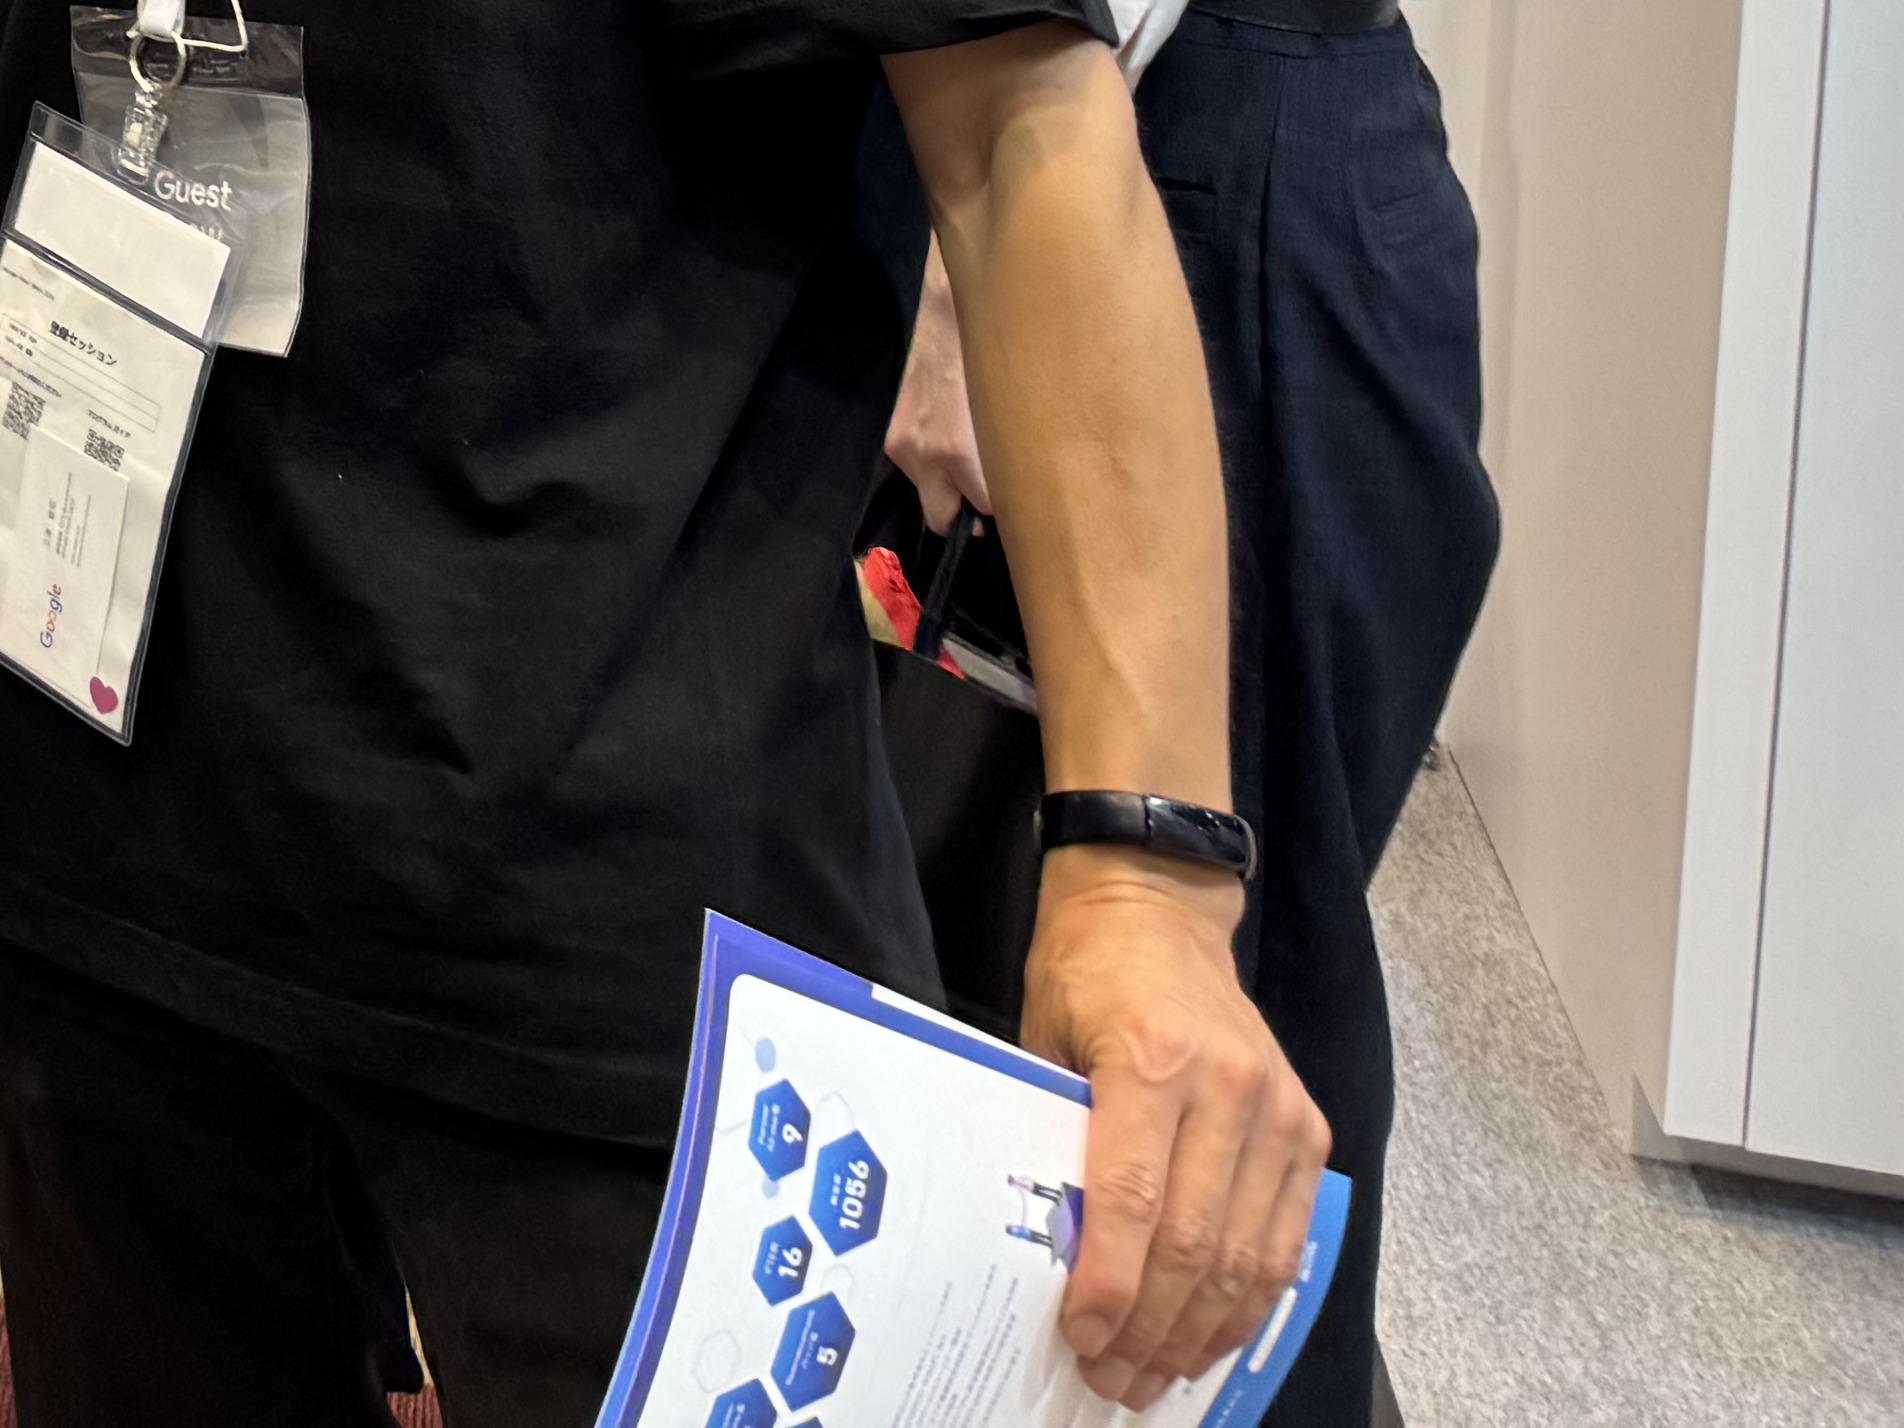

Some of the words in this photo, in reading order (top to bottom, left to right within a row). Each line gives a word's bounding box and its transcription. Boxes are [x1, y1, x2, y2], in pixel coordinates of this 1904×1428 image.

[154, 169, 233, 212] Guest
[39, 582, 65, 651] Google
[780, 1122, 804, 1144] 9
[838, 1158, 871, 1231] 1056
[777, 1246, 802, 1279] 16
[815, 1344, 838, 1366] 5
